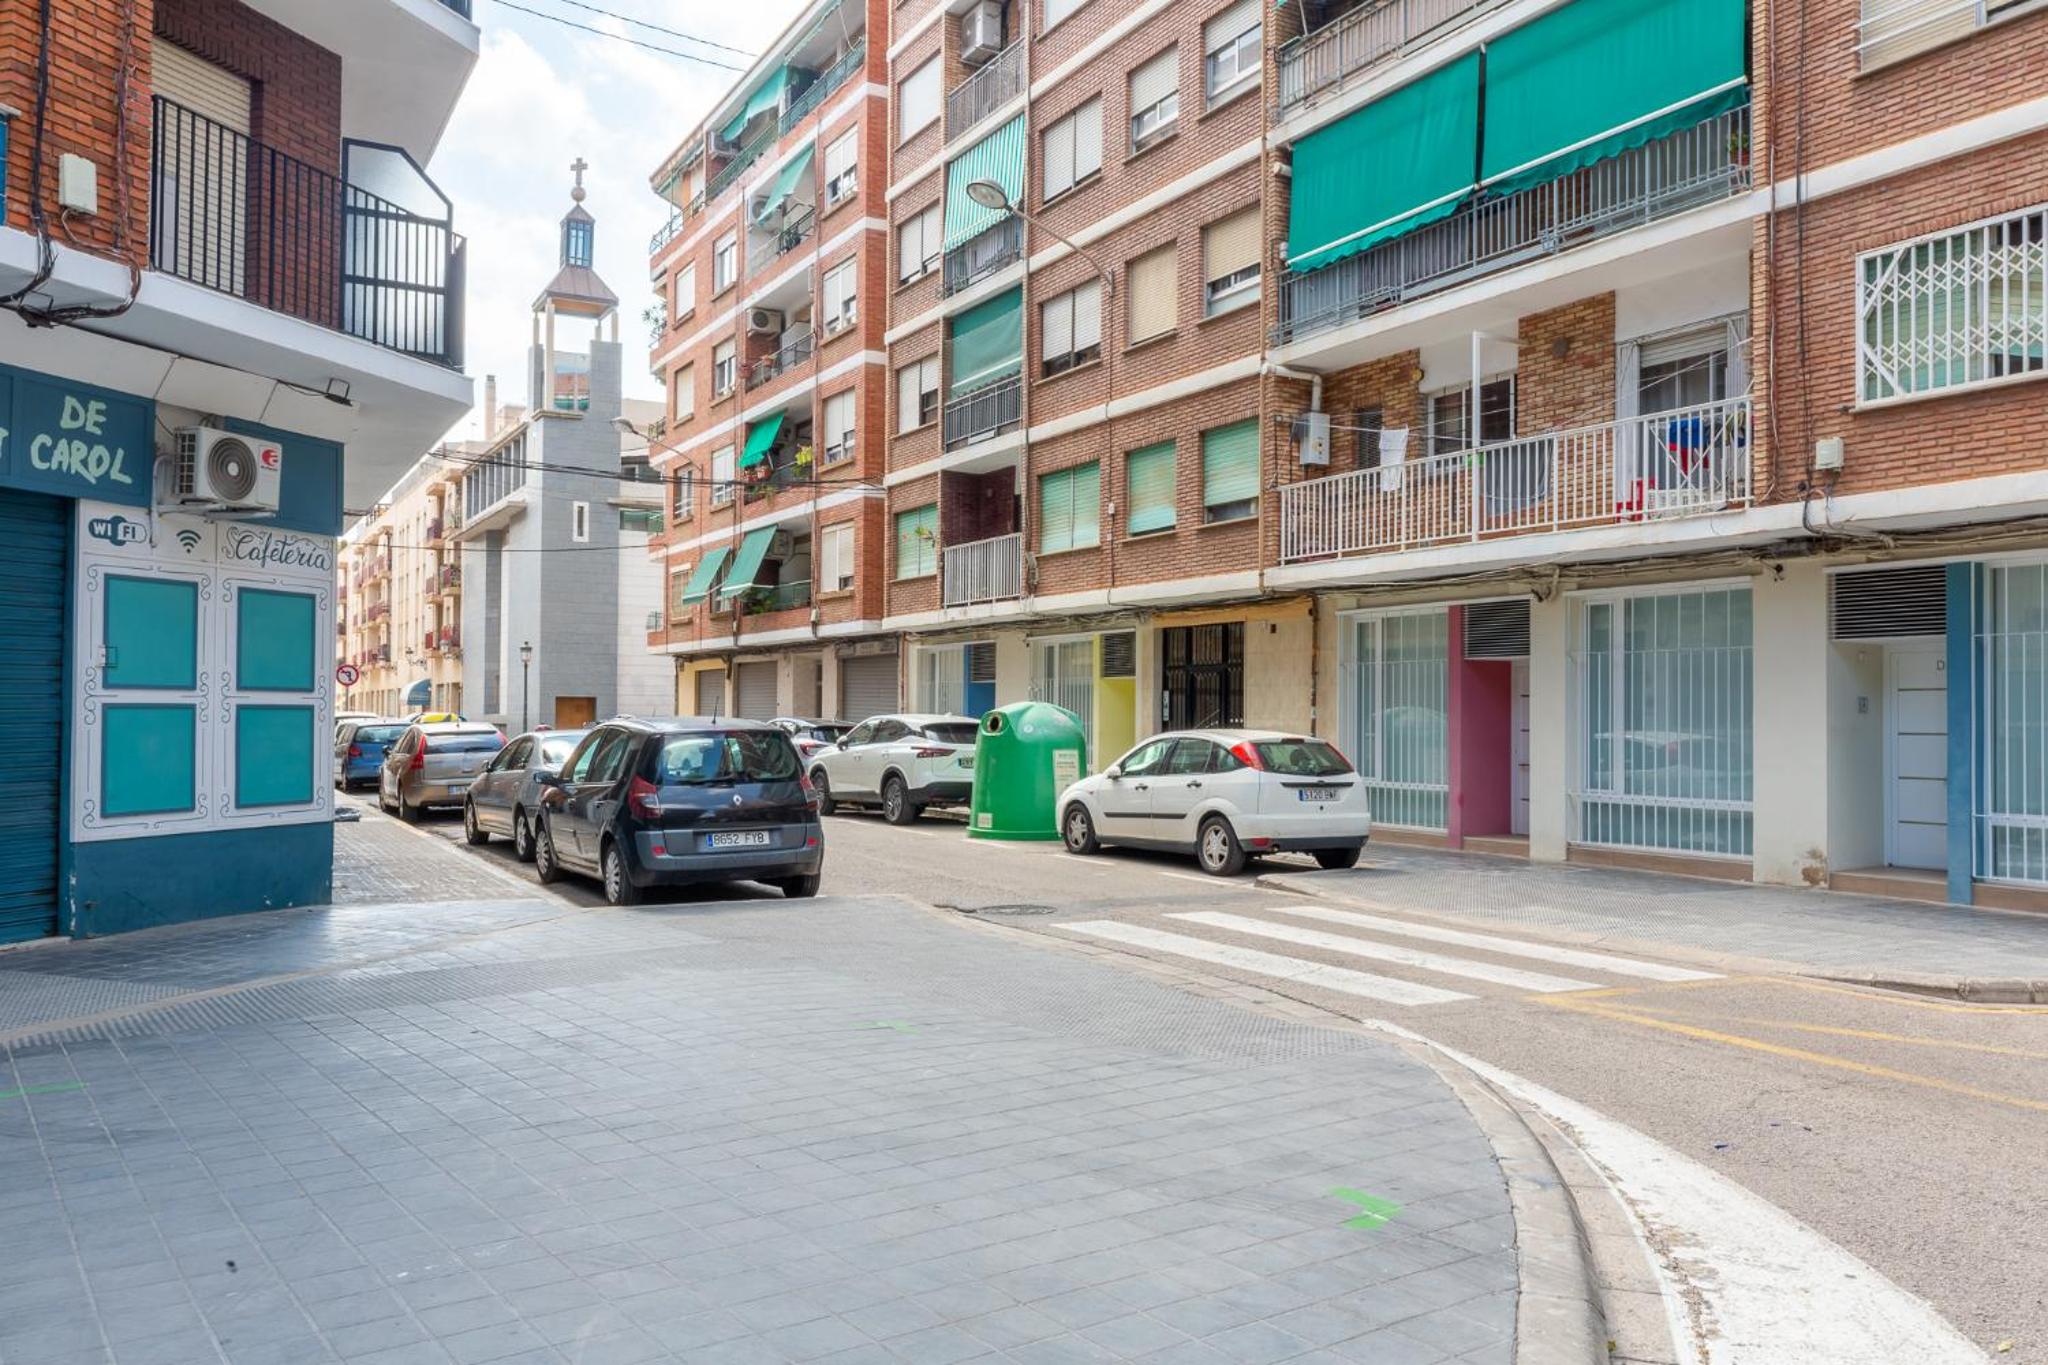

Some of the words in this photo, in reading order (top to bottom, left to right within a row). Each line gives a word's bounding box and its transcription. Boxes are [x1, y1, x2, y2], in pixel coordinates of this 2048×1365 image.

[60, 395, 107, 435] DE
[30, 433, 133, 484] CAROL
[713, 833, 740, 845] 8652
